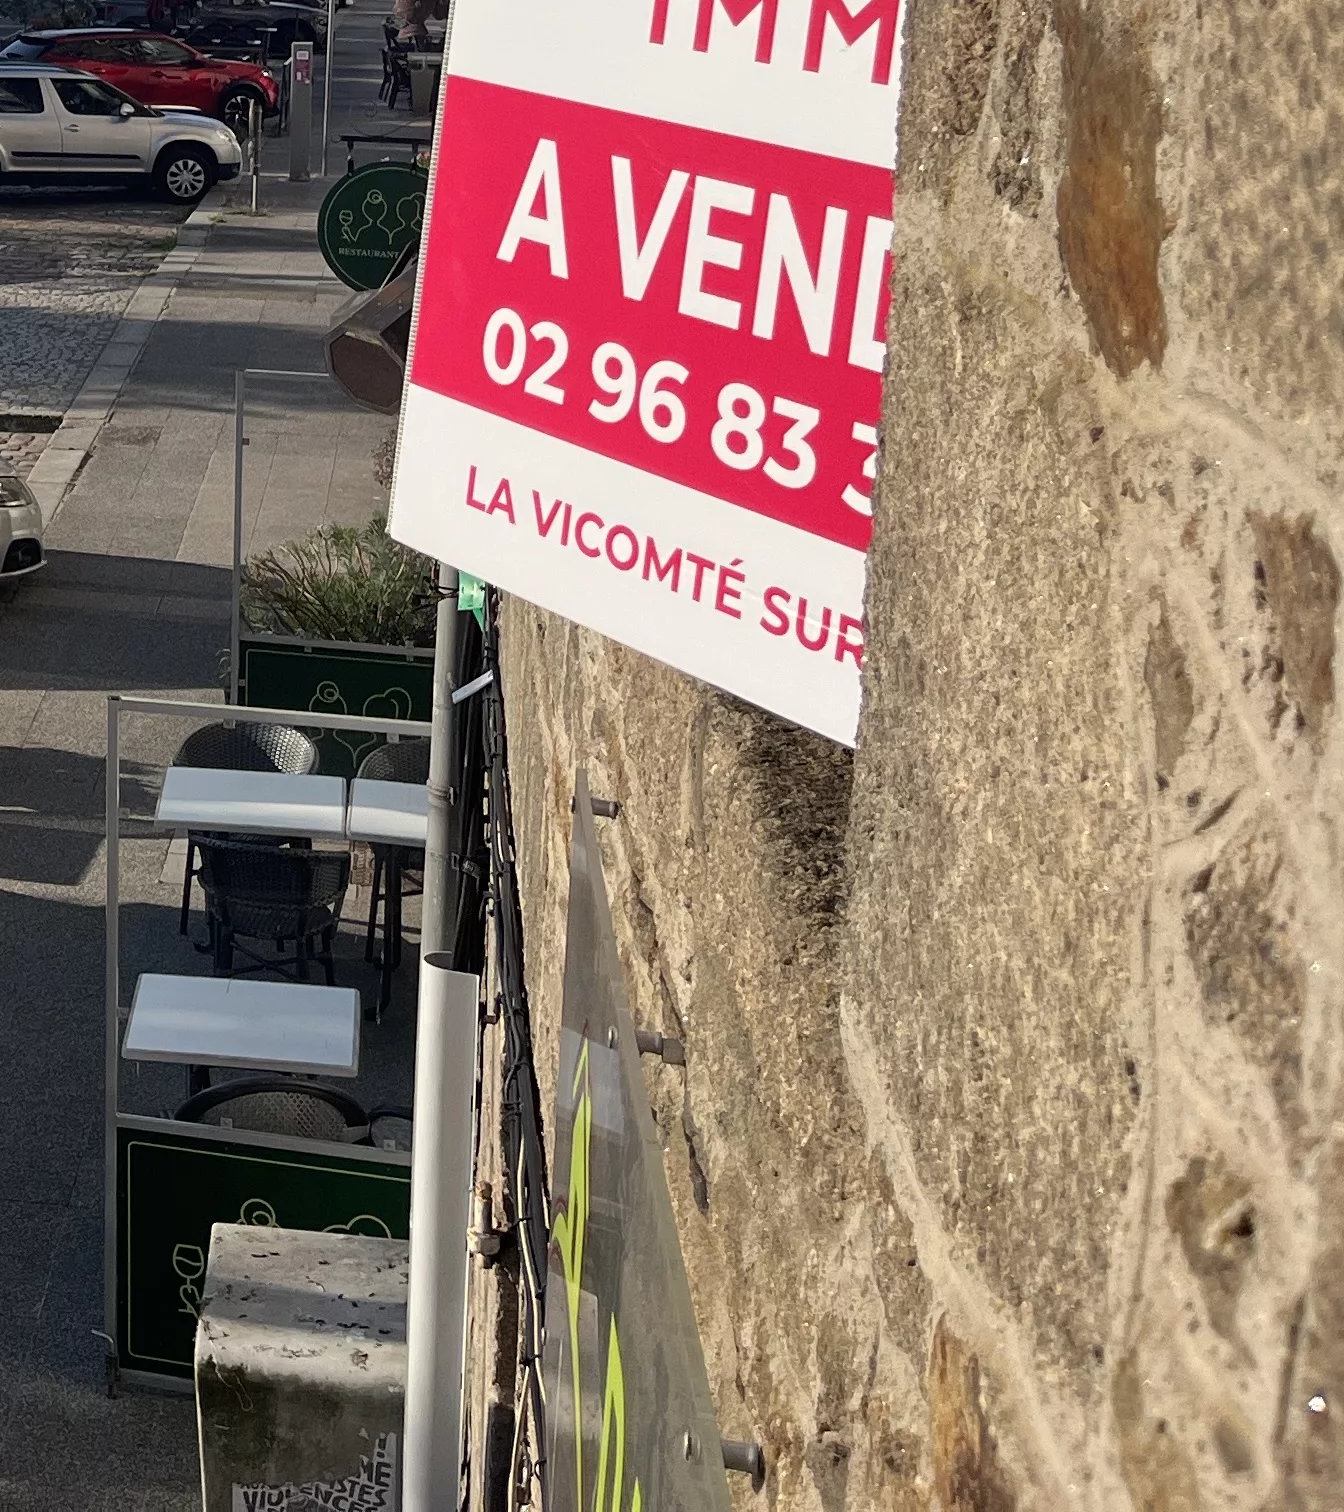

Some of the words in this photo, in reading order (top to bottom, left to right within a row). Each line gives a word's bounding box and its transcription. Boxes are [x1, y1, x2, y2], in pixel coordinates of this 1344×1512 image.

[338, 247, 400, 259] RESTAURANT
[496, 137, 569, 279] A
[482, 307, 570, 406] 02
[588, 341, 691, 443] 96
[710, 382, 820, 489] 83
[465, 464, 517, 525] LA
[532, 489, 747, 619] VICOMTÉ
